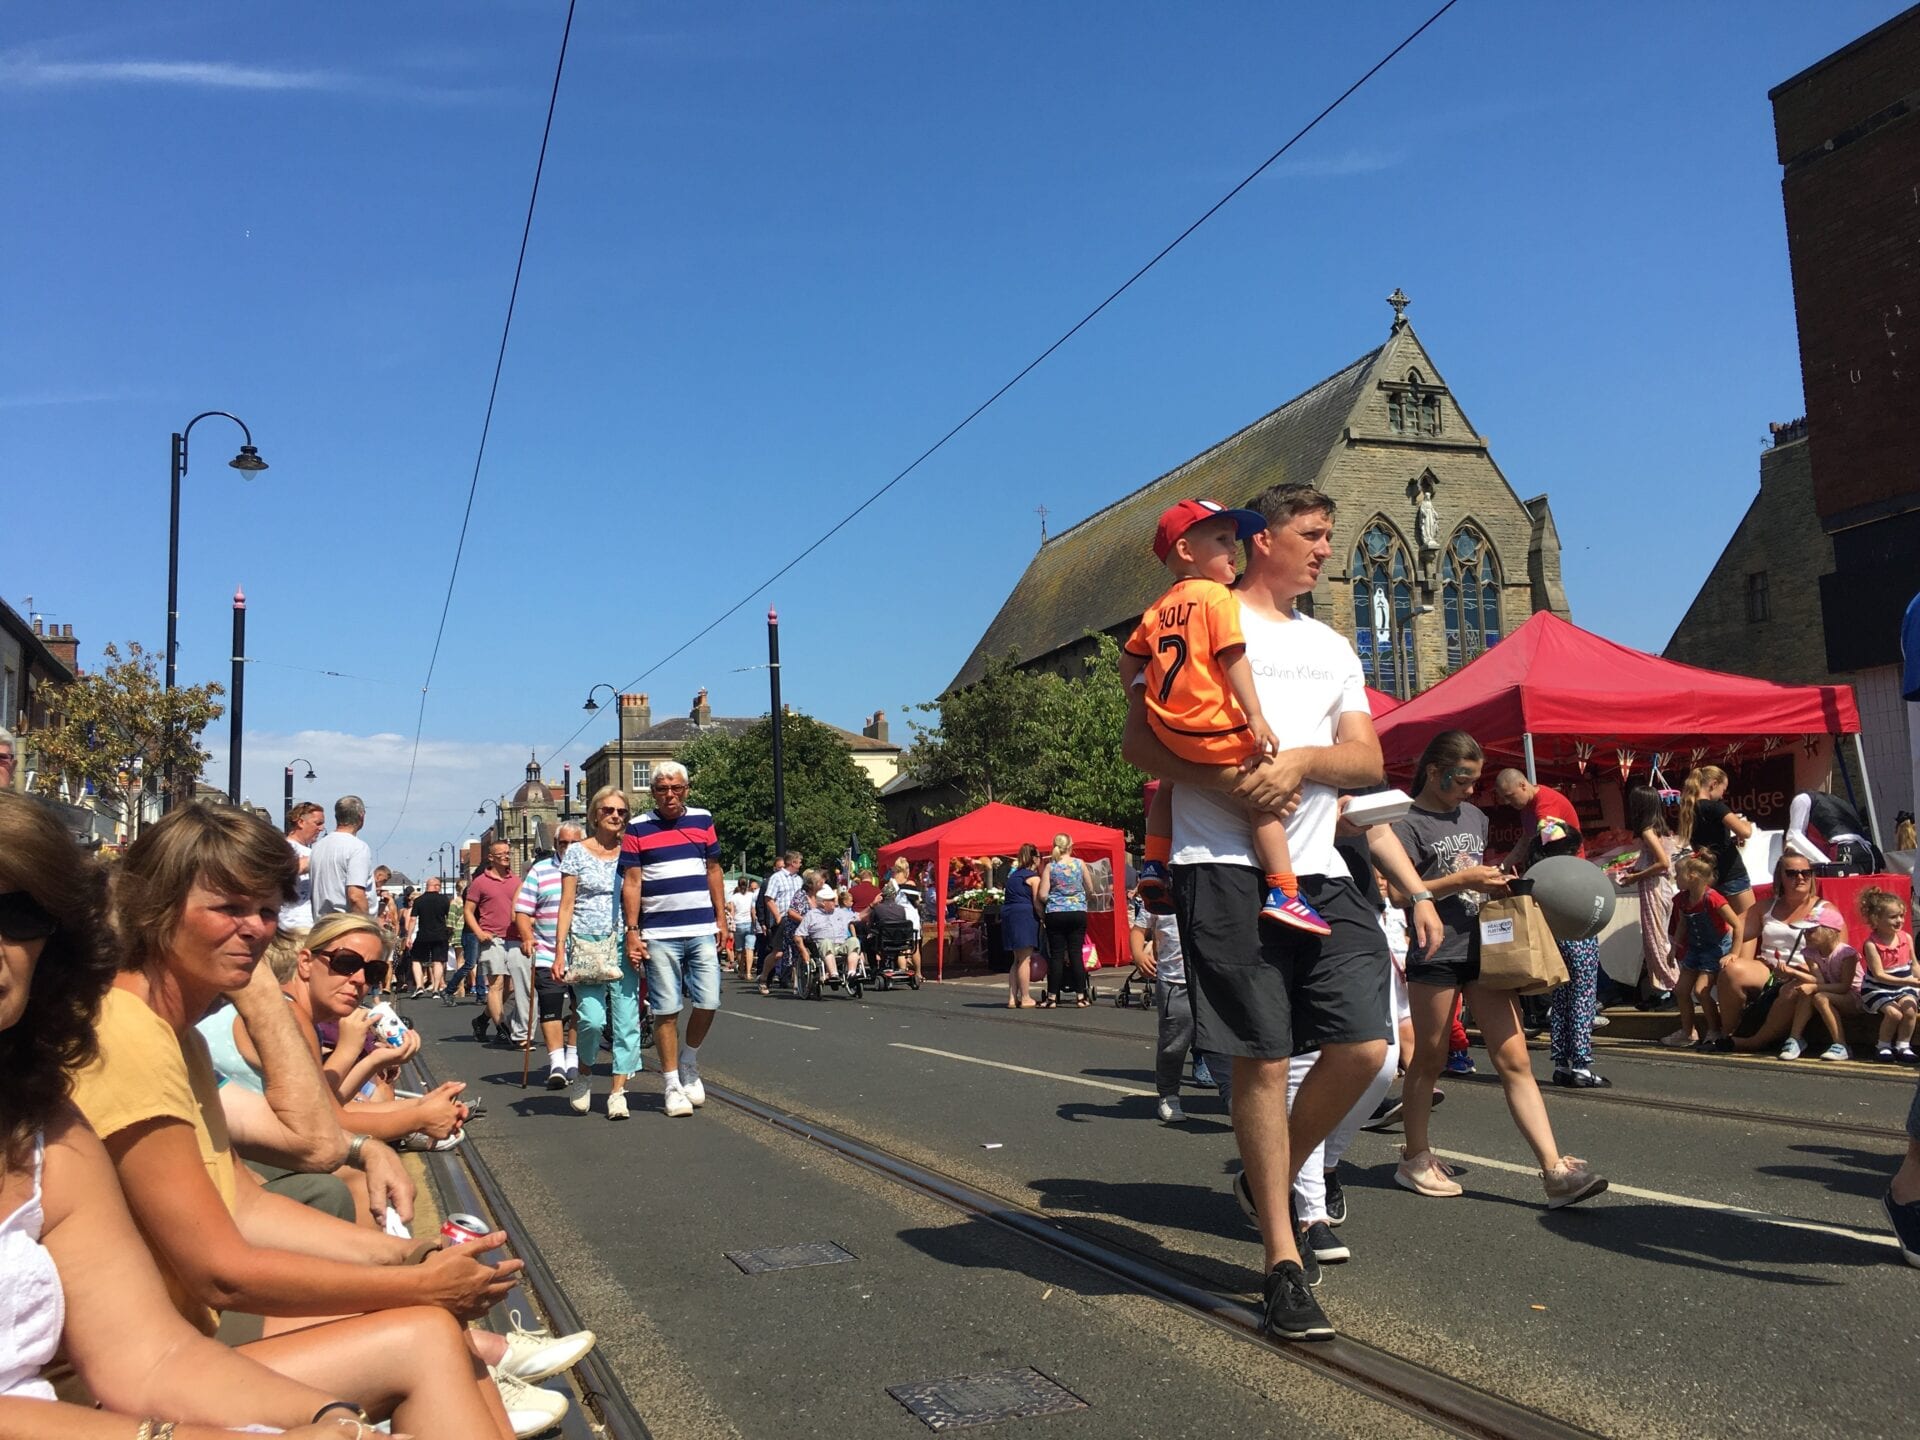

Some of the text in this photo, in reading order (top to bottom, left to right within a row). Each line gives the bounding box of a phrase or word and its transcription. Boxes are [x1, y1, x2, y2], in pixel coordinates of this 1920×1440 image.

[1159, 602, 1198, 630] HOLT
[1157, 633, 1188, 705] 7
[1250, 658, 1334, 681] Calvin Klein
